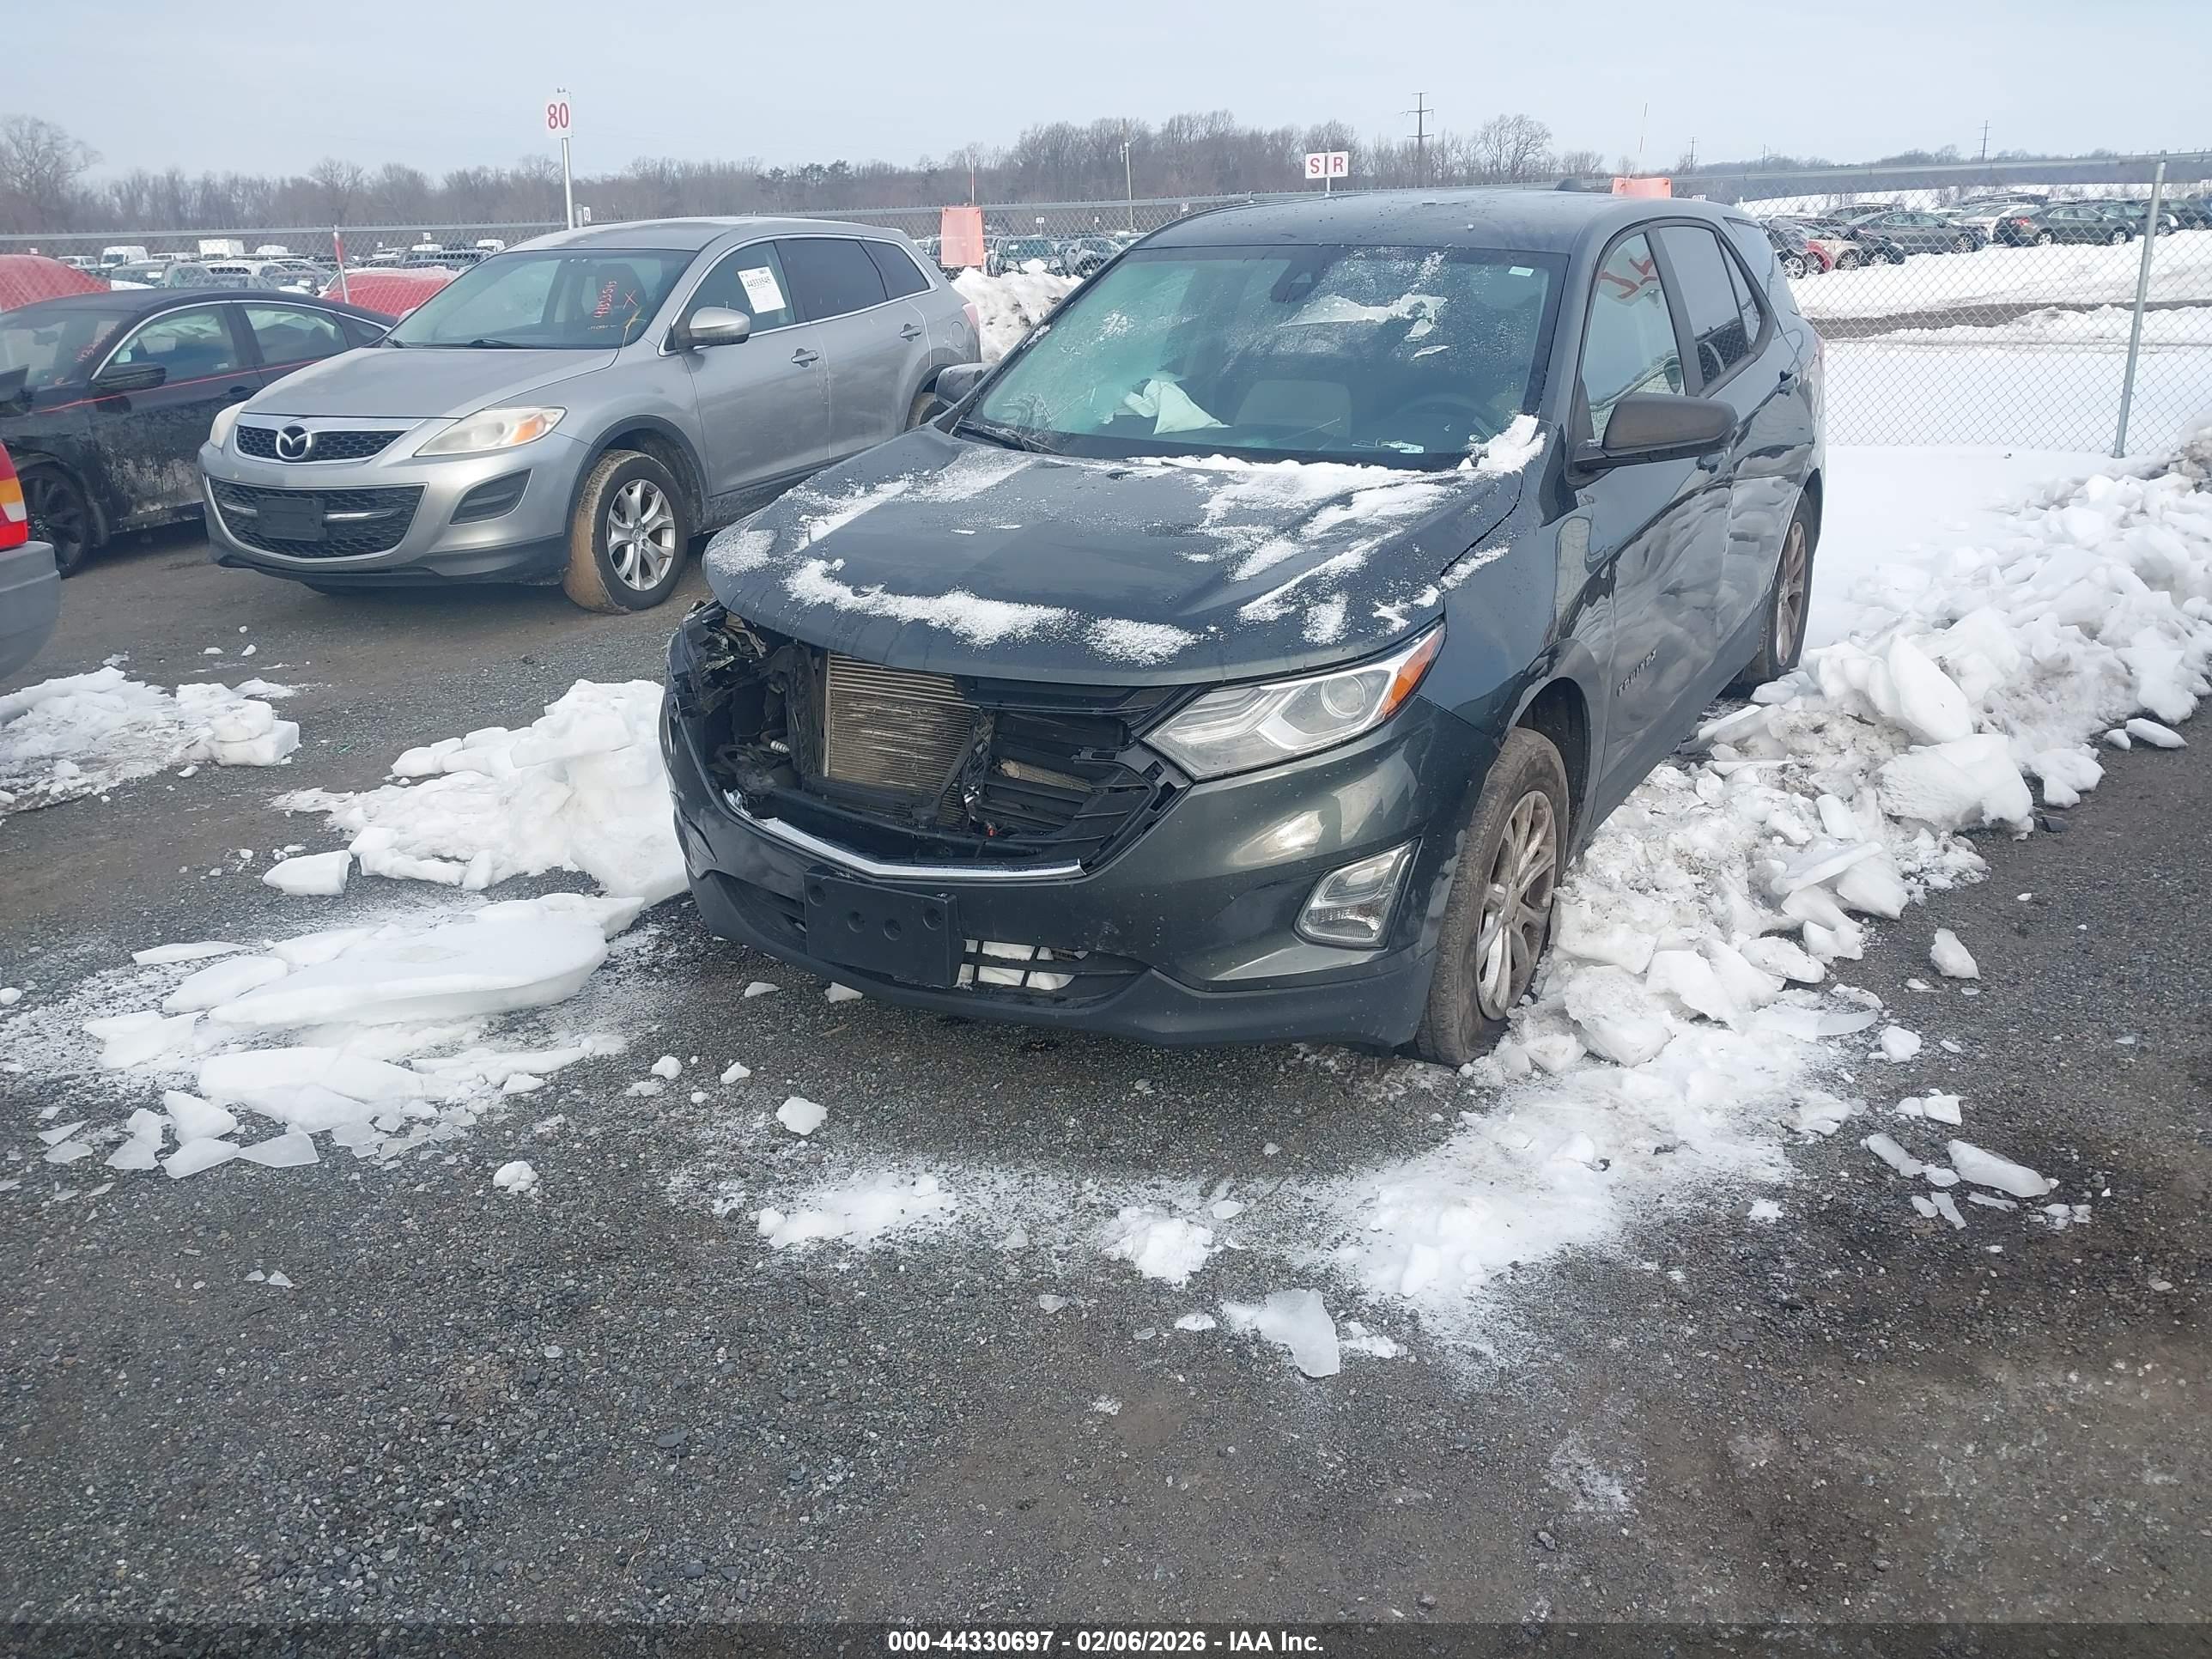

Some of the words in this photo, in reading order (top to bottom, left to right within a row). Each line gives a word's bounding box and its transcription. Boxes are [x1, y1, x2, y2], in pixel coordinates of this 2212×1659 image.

[548, 102, 569, 129] 80
[1310, 157, 1321, 174] S
[1333, 156, 1344, 173] R
